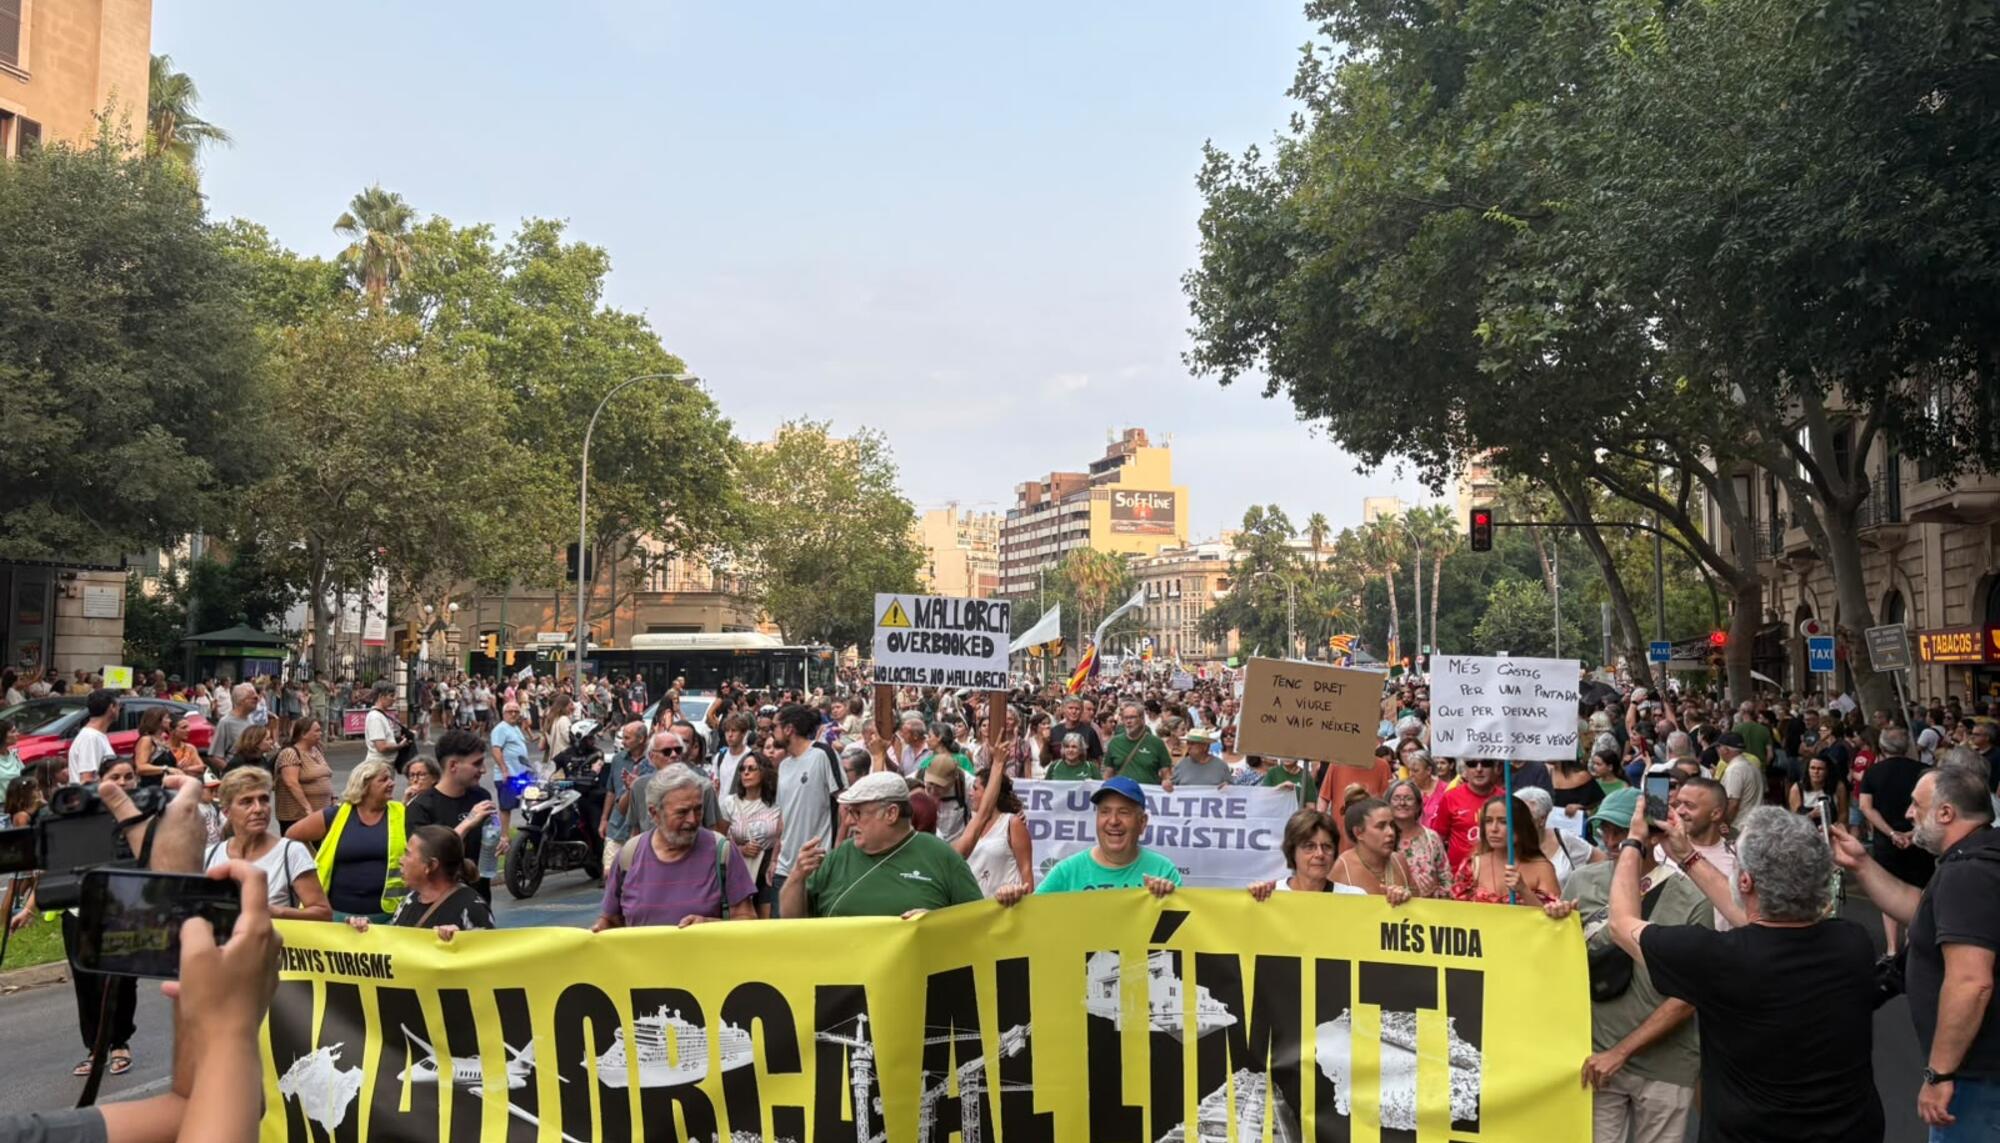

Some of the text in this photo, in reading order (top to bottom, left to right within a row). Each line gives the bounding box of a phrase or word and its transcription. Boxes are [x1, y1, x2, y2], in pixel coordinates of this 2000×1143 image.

[914, 598, 1010, 634] MALLORCA
[887, 632, 995, 658] OVERBOOKED
[1811, 649, 1833, 659] TAXI
[1932, 633, 1972, 654] TABACOS
[1449, 658, 1481, 675] MÉS
[874, 666, 887, 683] NO
[930, 668, 944, 685] NO
[946, 670, 1007, 689] MALLORCA
[1272, 675, 1347, 696] TENC DRET
[1272, 696, 1282, 709] A
[1460, 684, 1578, 702] PER UNA PINTADA
[1260, 713, 1277, 724] ON
[1286, 715, 1314, 728] VAIG
[1438, 705, 1548, 718] QUE PER DEIXAR
[1436, 729, 1454, 743] UN
[1466, 728, 1504, 744] POBLE
[1510, 731, 1541, 745] SENSE
[1013, 789, 1053, 811] ER
[1028, 819, 1271, 851] DEL URÍSTIC
[1380, 918, 1483, 958] MÉS VIDA
[324, 950, 394, 979] TURISME
[918, 956, 1055, 1143] AL
